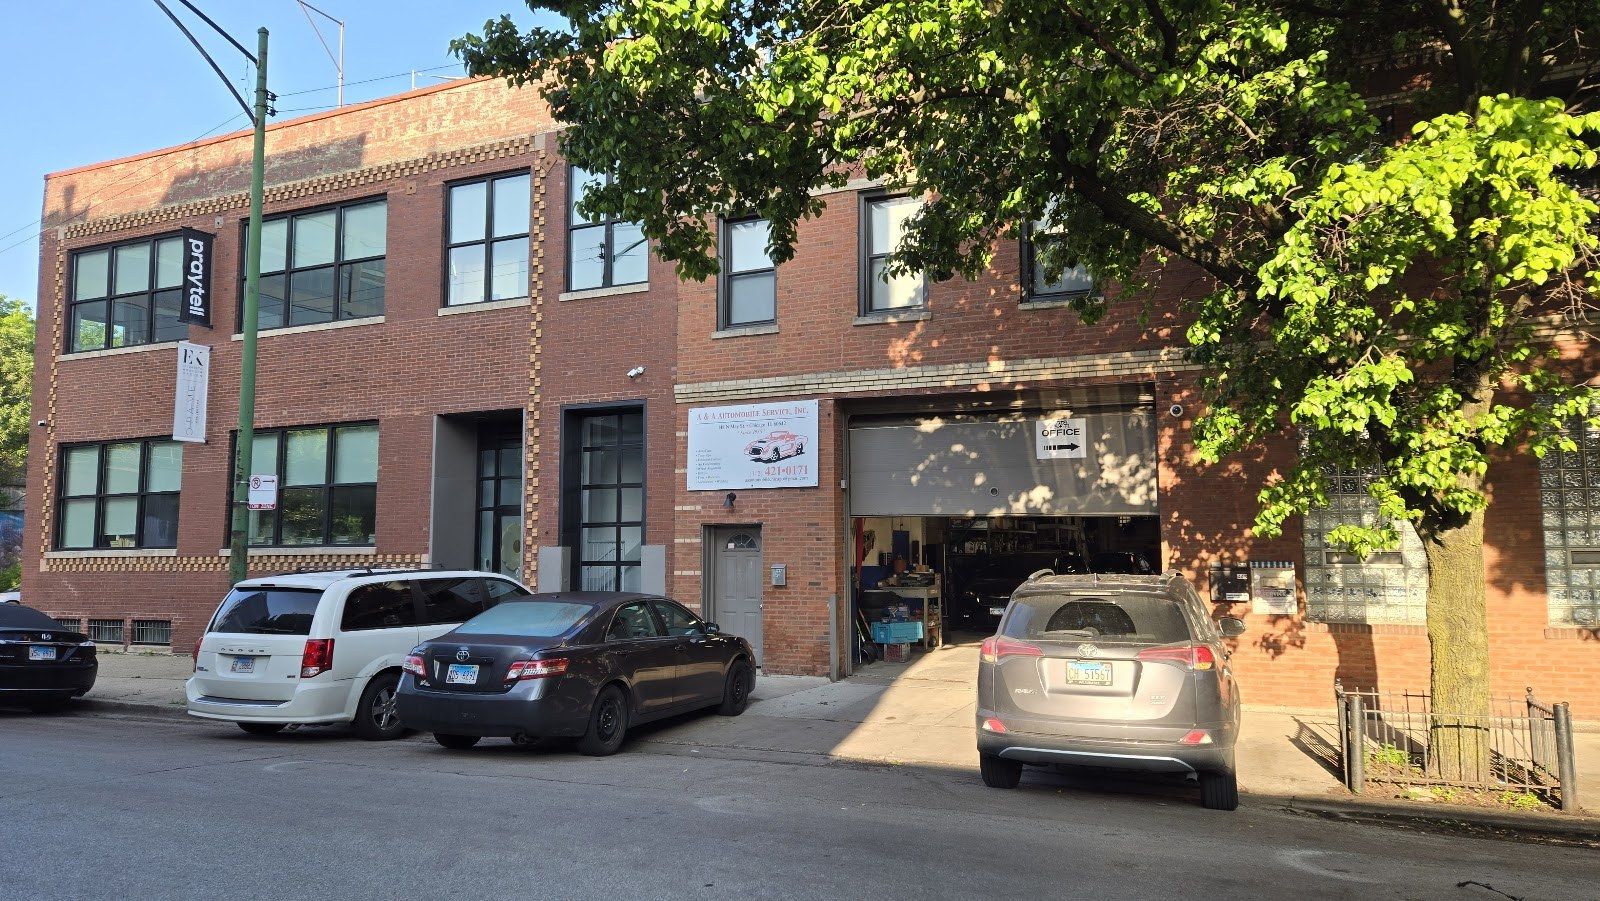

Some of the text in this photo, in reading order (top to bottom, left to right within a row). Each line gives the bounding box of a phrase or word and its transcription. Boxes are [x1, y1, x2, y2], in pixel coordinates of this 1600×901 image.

[188, 238, 205, 317] praytell
[711, 412, 716, 420] A
[718, 410, 760, 420] AUTOMOBILE
[794, 406, 809, 415] INC.
[1041, 428, 1081, 437] OFFICE
[1068, 668, 1080, 680] CH
